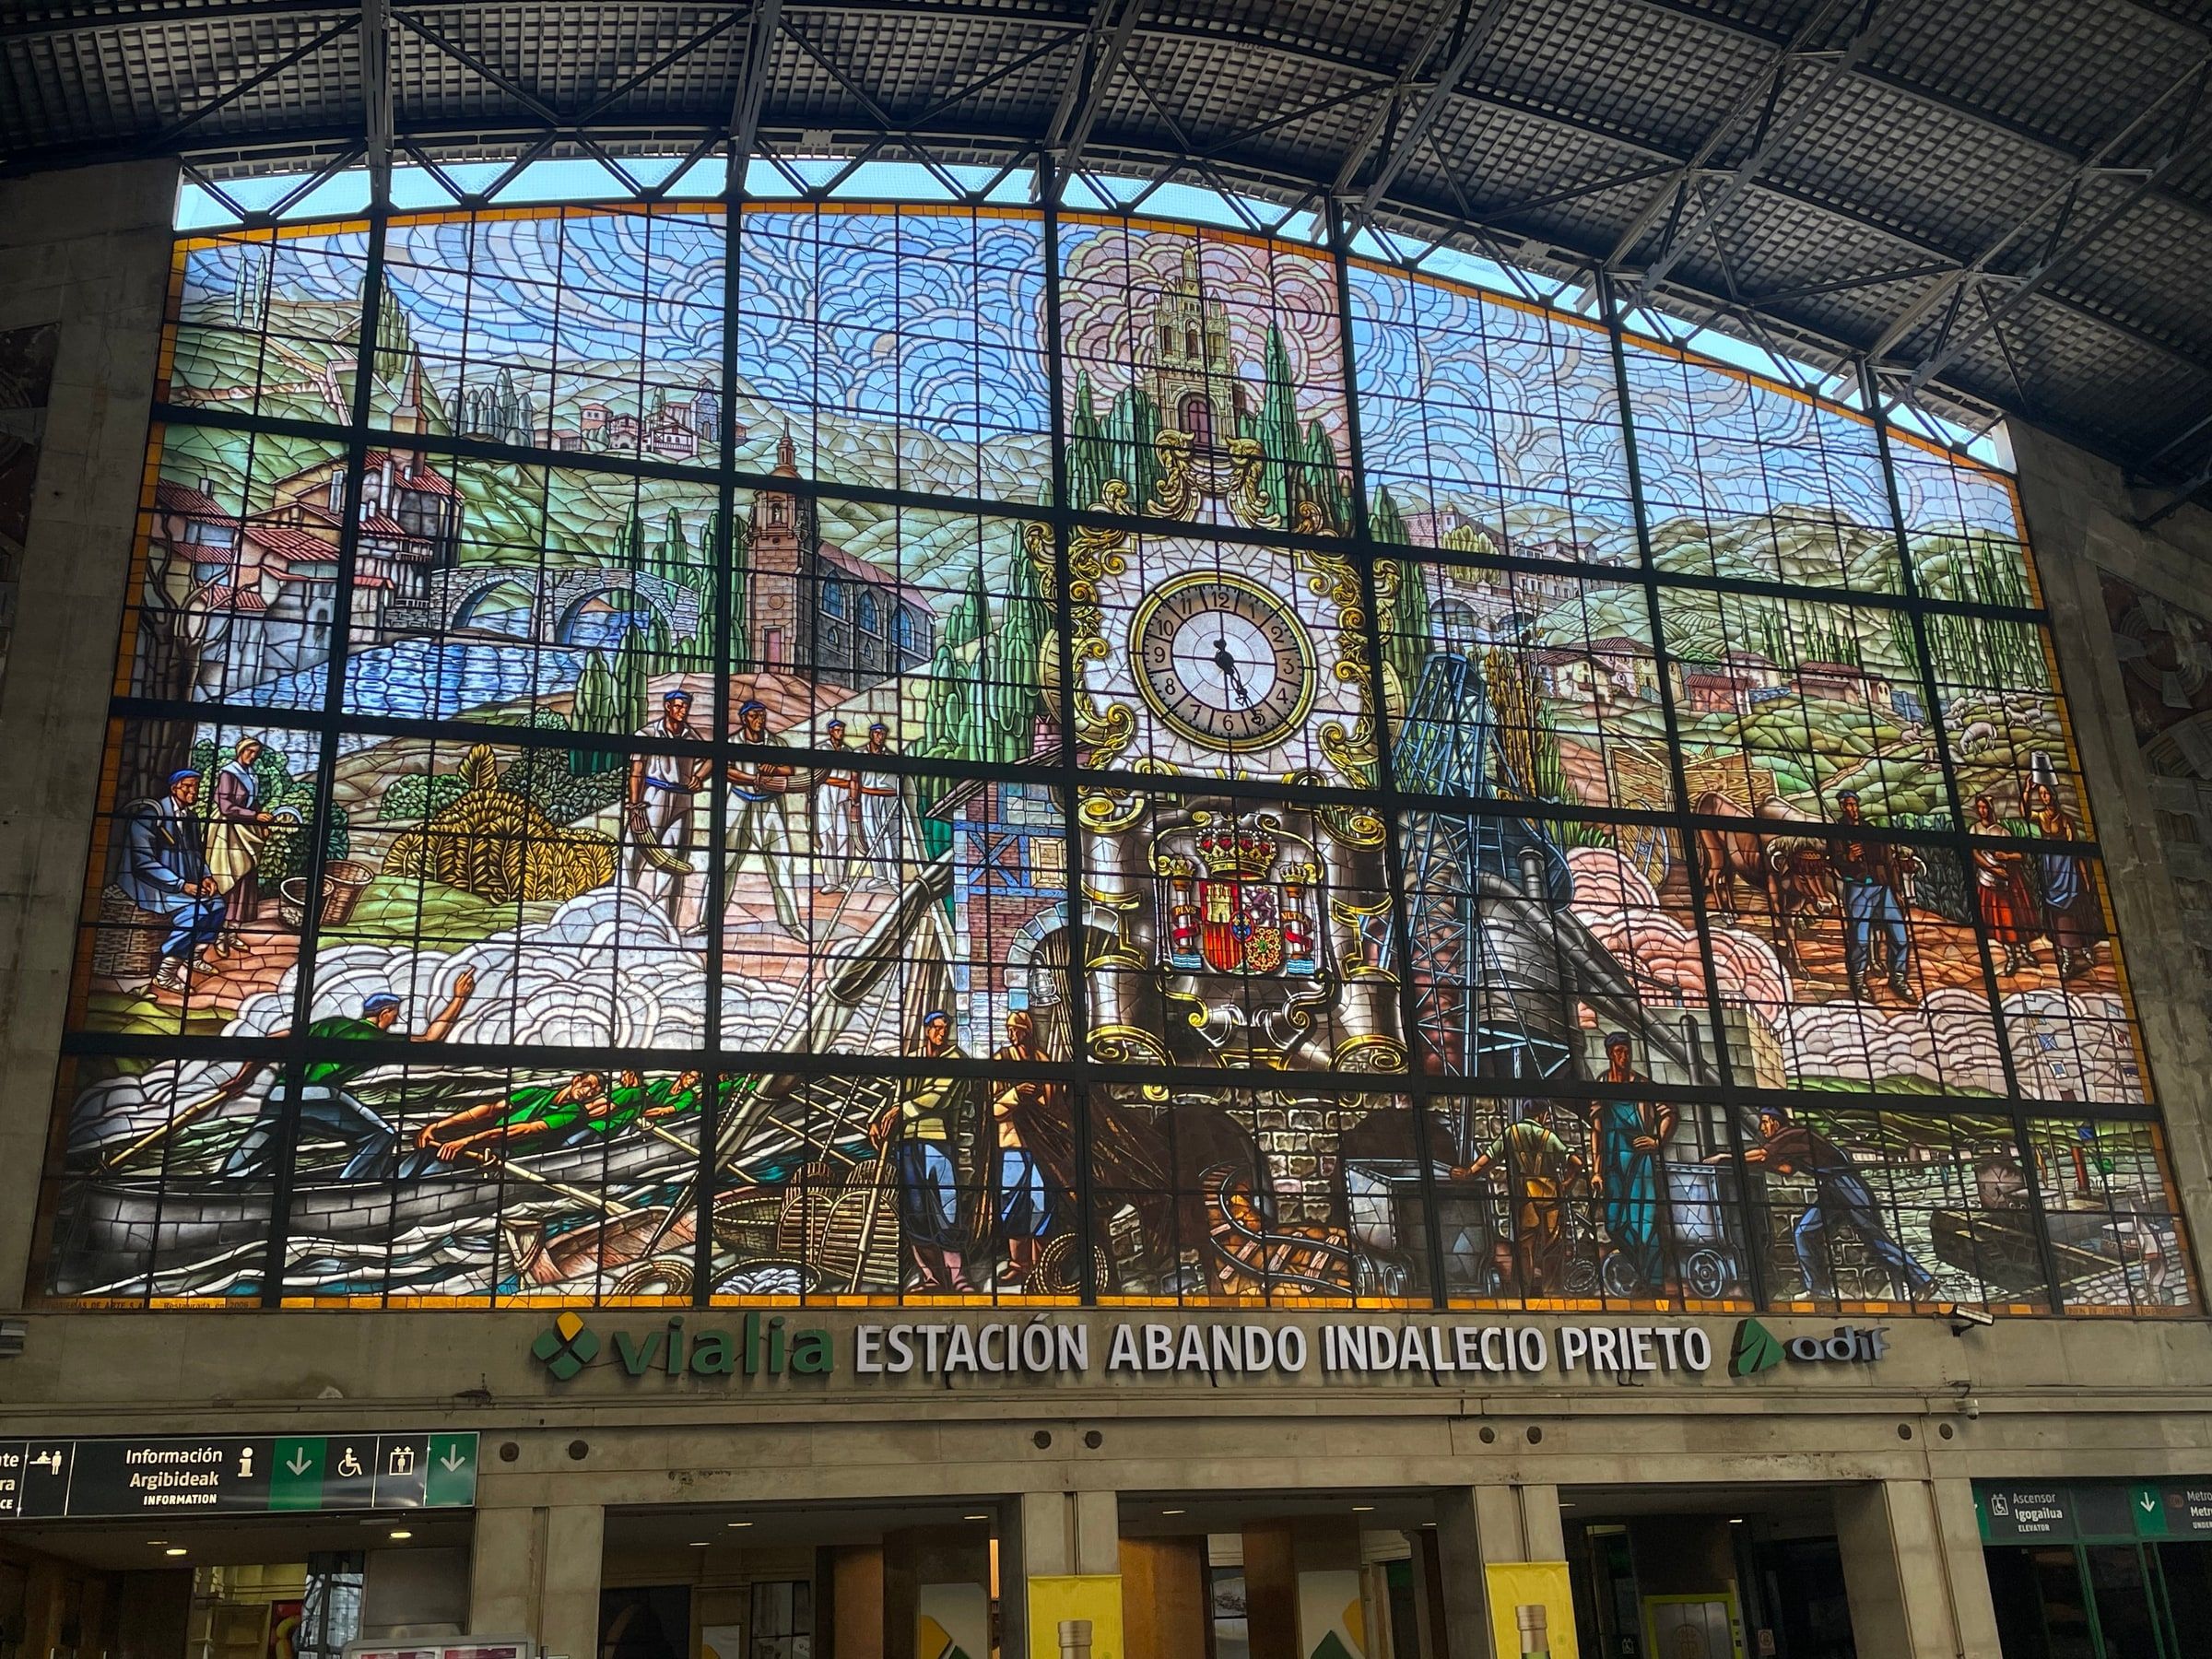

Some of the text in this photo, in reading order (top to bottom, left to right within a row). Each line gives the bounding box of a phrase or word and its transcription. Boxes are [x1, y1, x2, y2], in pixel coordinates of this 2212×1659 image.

[1181, 599, 1193, 615] 11
[1211, 592, 1230, 608] 12
[1249, 602, 1256, 618] 1
[1157, 620, 1174, 636] 10
[1271, 627, 1284, 642] 2
[1154, 647, 1166, 663] 9
[1283, 658, 1294, 675] 3
[1165, 678, 1175, 695] 8
[1276, 688, 1288, 703] 4
[1190, 703, 1202, 721] 7
[1223, 715, 1234, 732] 6
[1174, 906, 1196, 915] PLVS
[613, 1311, 834, 1375] vialia
[856, 1312, 1712, 1373] ESTACIÓN ABANDO INDALECIO PRIETO
[1792, 1324, 1890, 1360] adif
[125, 1447, 223, 1465] Información
[129, 1471, 219, 1490] Argibideak
[143, 1494, 218, 1506] INFORMATION
[2013, 1492, 2056, 1505] Ascensor
[2186, 1490, 2212, 1502] Metro
[2015, 1507, 2064, 1523] Igogailua
[2018, 1524, 2051, 1533] ELEVATOR
